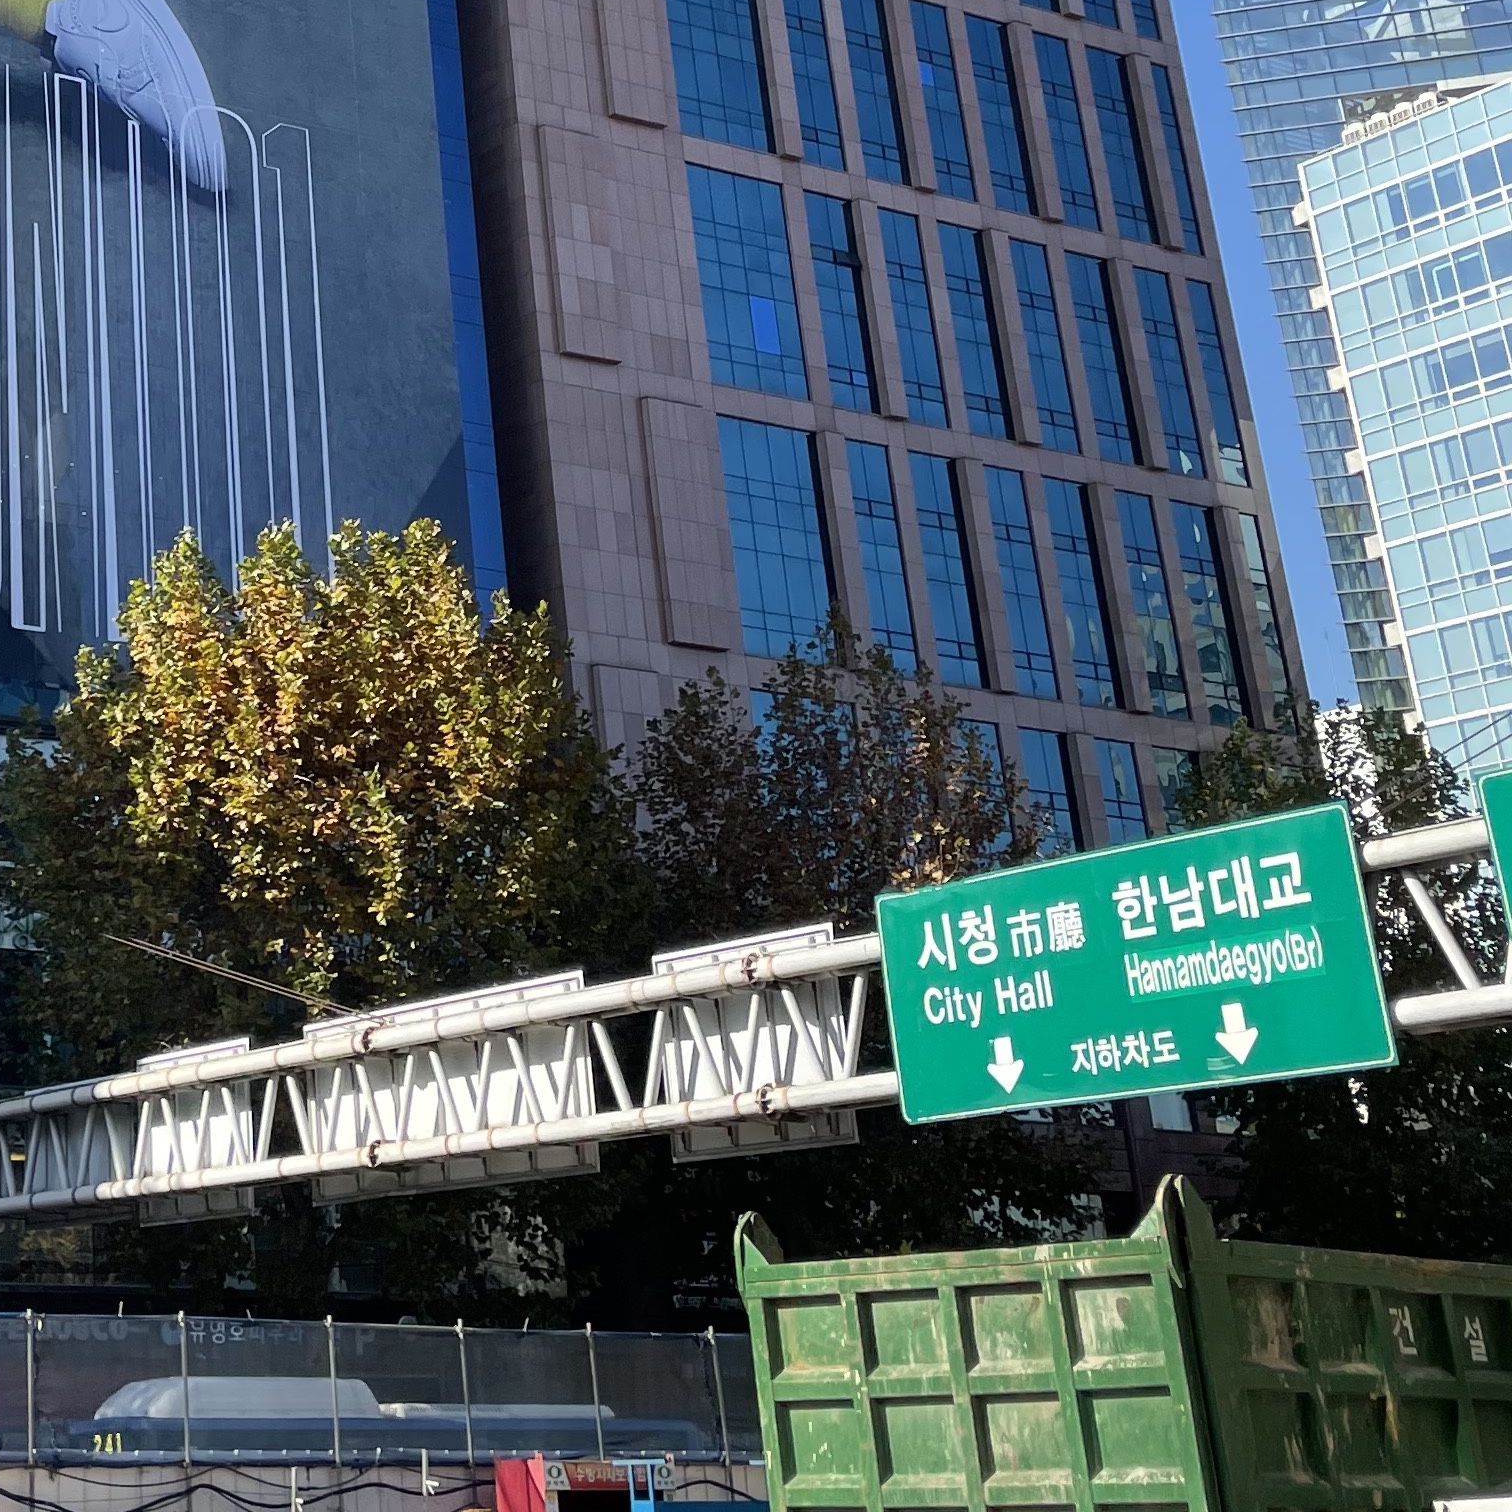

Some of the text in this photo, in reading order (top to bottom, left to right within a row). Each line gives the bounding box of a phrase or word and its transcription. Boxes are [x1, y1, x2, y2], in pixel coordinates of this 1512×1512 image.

[1112, 851, 1313, 941] 한남대교
[917, 901, 1087, 972] 시청 市廳
[1123, 925, 1324, 998] Hannamdaegyo(Br)
[923, 969, 1054, 1029] City Hall
[1070, 1029, 1181, 1076] 지하차도
